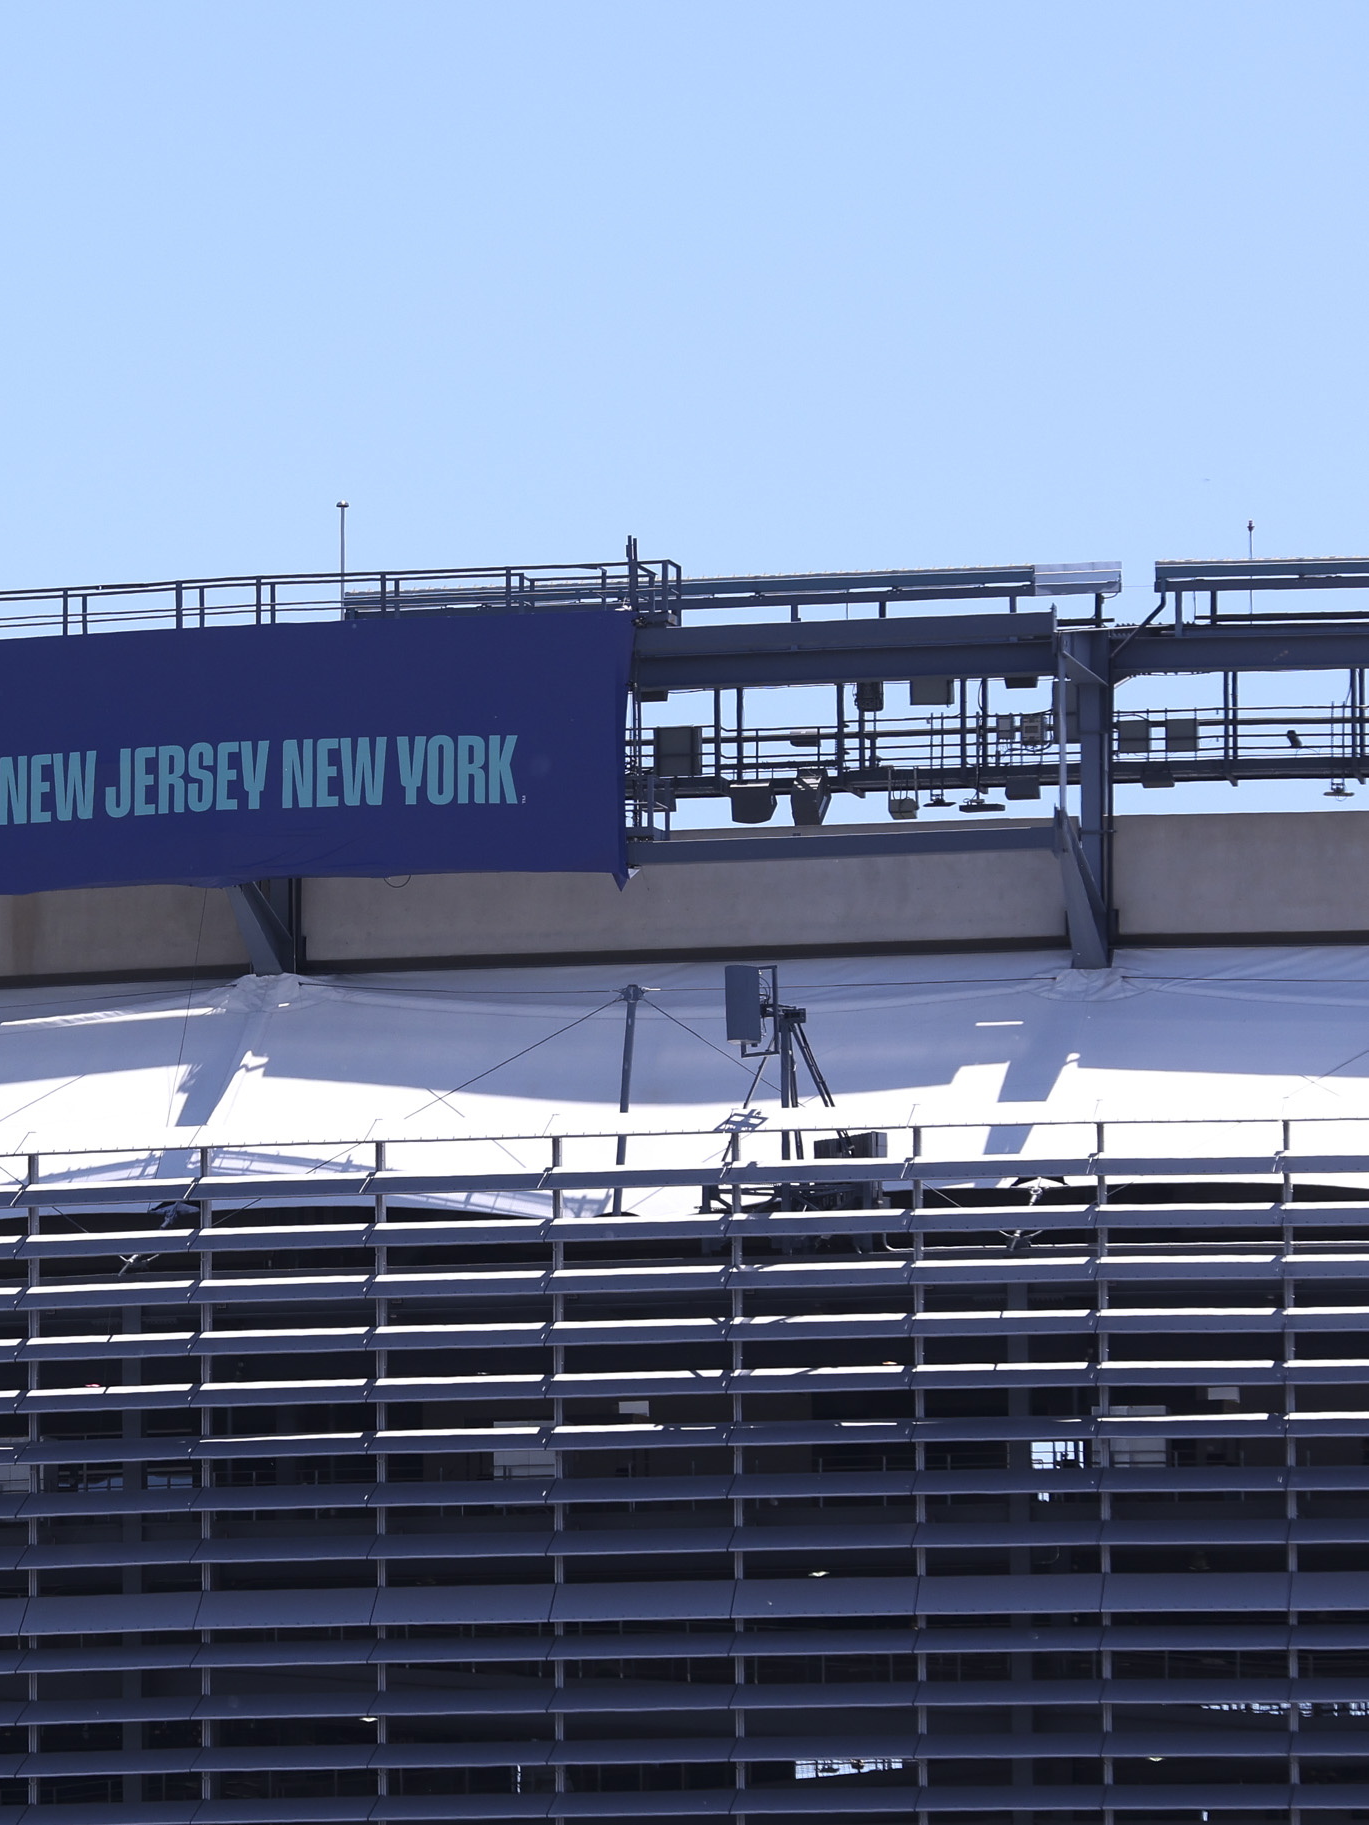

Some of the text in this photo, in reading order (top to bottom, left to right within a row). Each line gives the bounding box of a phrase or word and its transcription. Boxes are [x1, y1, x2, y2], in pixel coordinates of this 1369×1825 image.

[105, 740, 270, 819] JERSEY
[282, 736, 387, 810] NEW
[396, 735, 518, 806] YORK
